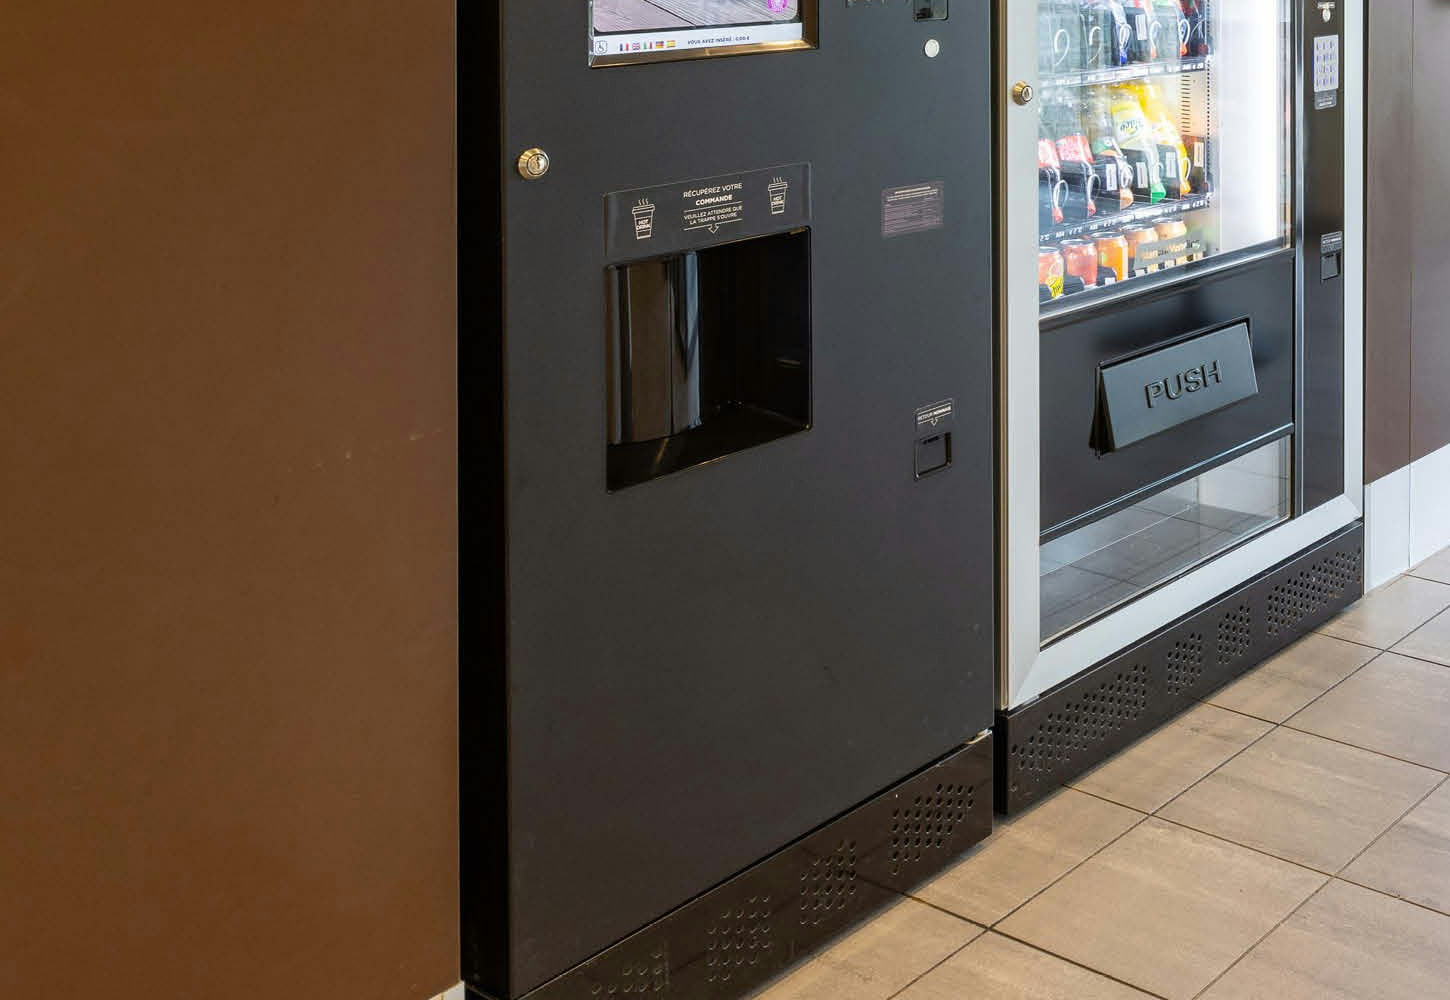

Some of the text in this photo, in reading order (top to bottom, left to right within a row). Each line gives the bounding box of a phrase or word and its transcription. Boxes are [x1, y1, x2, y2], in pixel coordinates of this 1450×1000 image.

[683, 182, 743, 199] RÉCUPÉREZ VOTRE
[695, 194, 733, 206] COMMANDE
[707, 208, 732, 216] ATTENDRE
[1144, 359, 1223, 409] PUSH
